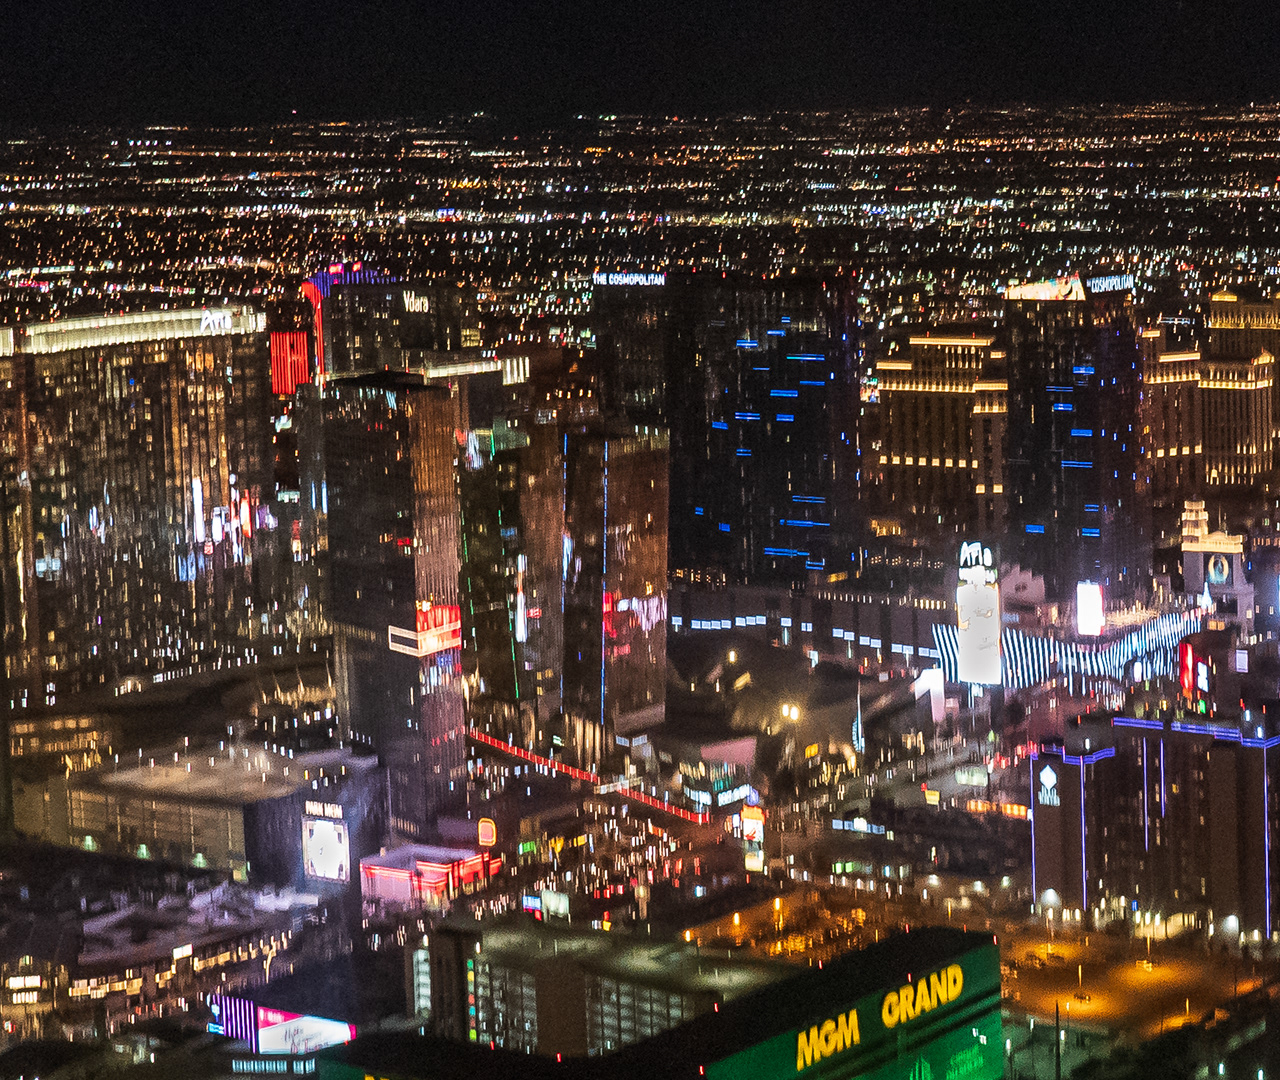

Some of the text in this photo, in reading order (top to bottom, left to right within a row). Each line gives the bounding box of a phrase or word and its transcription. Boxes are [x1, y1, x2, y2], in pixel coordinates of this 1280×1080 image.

[592, 272, 666, 286] THE COSMOPOLITAN
[1091, 274, 1134, 293] COSMOPOLITAN
[403, 290, 430, 313] Vdara
[796, 963, 963, 1072] MGM GRAND
